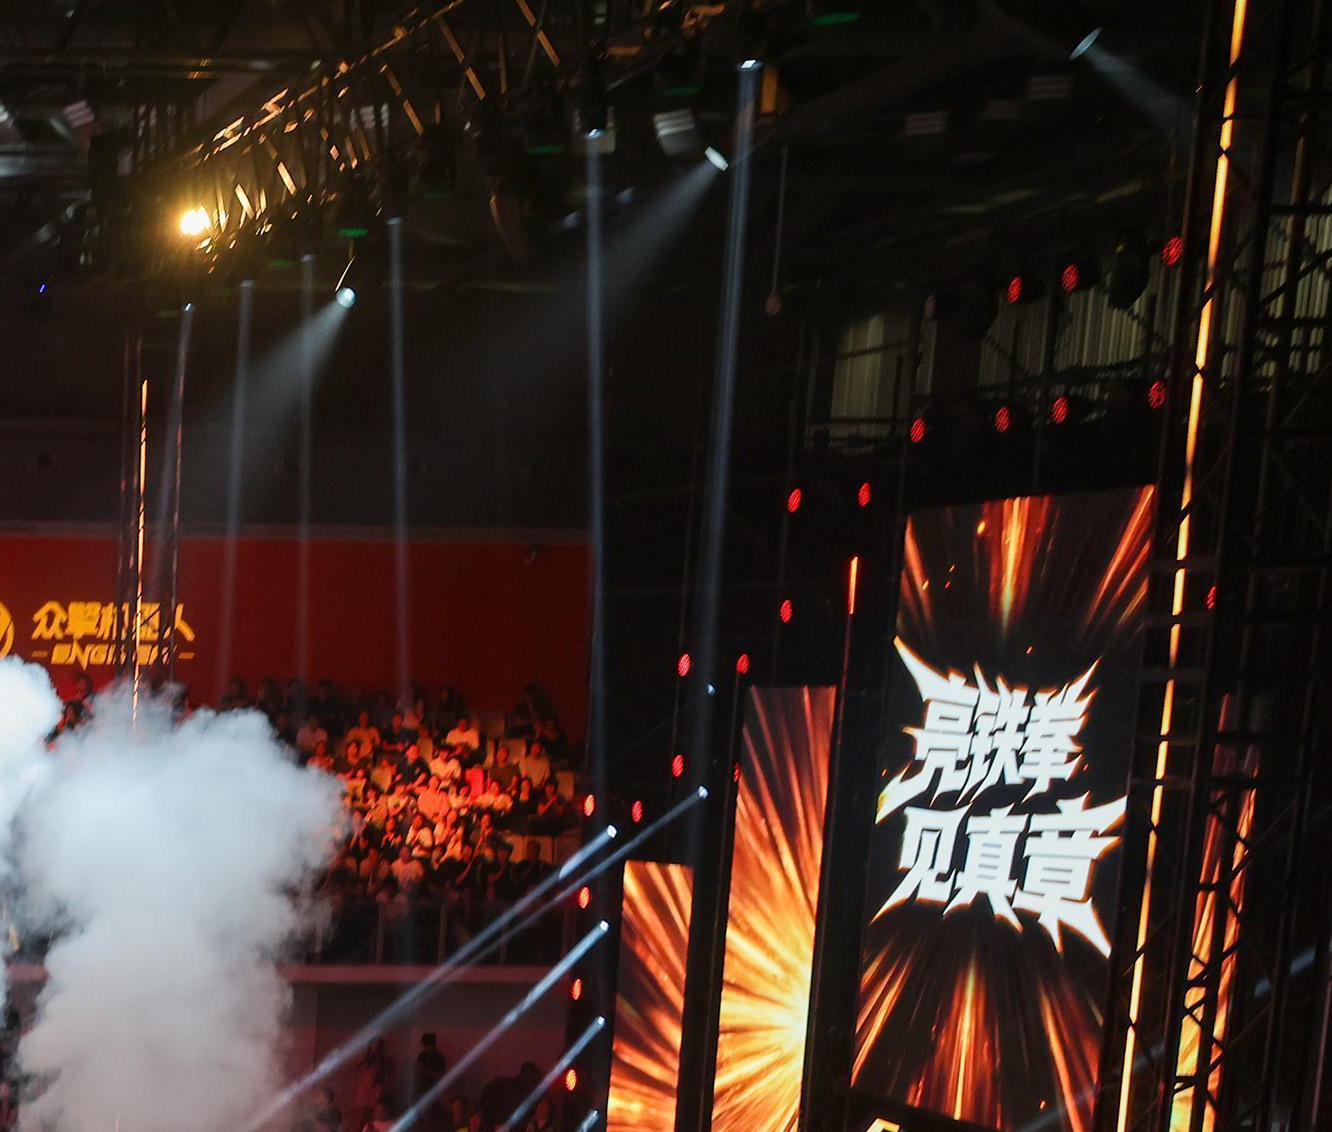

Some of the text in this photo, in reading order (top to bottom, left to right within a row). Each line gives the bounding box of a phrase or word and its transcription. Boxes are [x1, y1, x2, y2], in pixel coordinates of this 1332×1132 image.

[876, 636, 1102, 824] 亮铁拳
[869, 792, 1128, 958] 见真章
